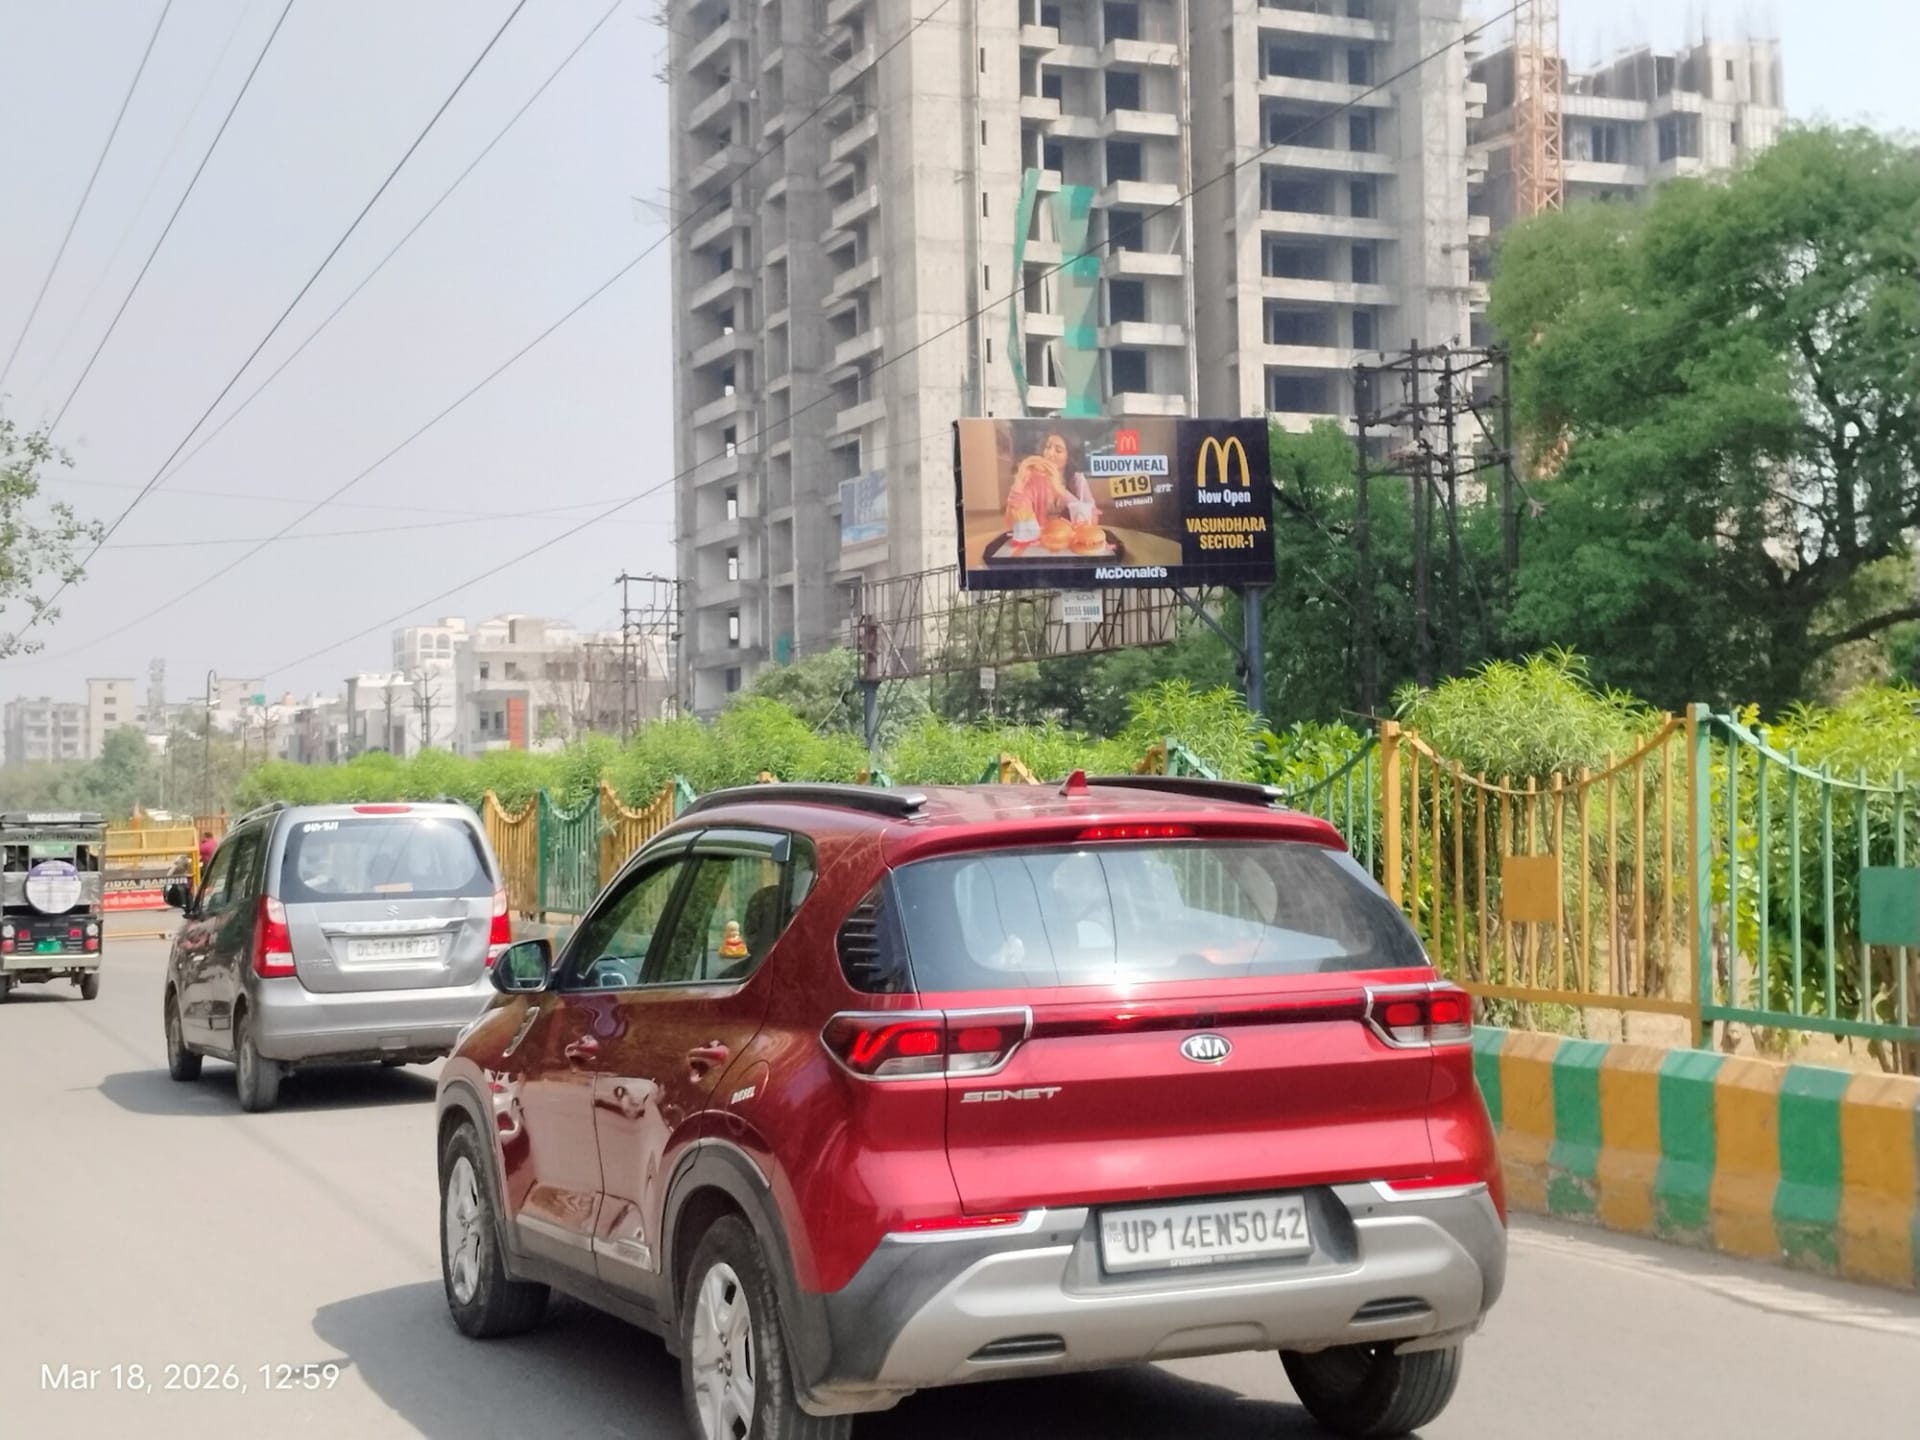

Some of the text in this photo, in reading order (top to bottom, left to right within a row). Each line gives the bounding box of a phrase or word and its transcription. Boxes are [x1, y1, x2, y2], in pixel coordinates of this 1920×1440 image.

[1093, 459, 1166, 472] BUDDY MEAL
[1198, 489, 1251, 507] Now Open
[1186, 517, 1266, 533] VASUNDHARA
[1199, 534, 1254, 550] SECTOR-1
[1095, 566, 1168, 579] McDonald's
[1189, 1038, 1227, 1058] KIA
[960, 1086, 1062, 1103] SONET
[1122, 1207, 1305, 1254] UP14EN5042
